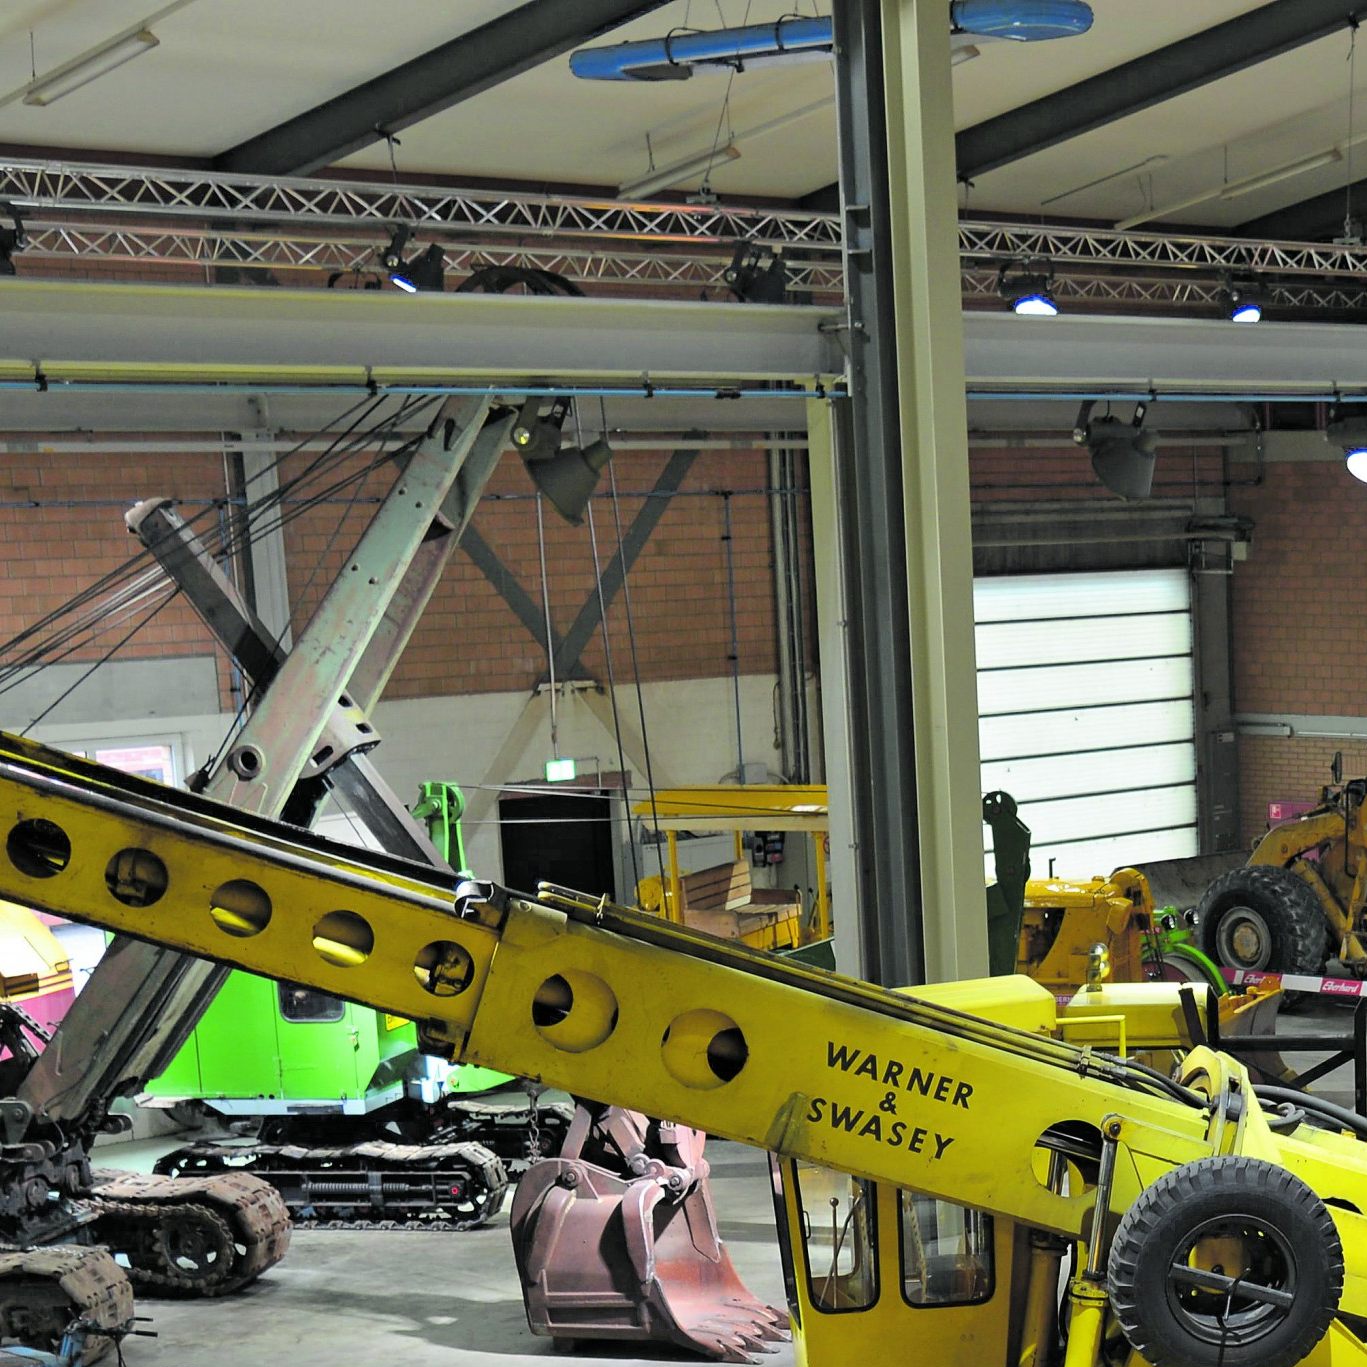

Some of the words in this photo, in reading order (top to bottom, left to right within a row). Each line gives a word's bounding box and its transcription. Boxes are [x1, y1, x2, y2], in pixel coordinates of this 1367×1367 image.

[1321, 980, 1359, 993] Eberhard
[827, 1041, 974, 1110] WARNER
[878, 1091, 898, 1116] &
[806, 1097, 955, 1161] SWASEY
